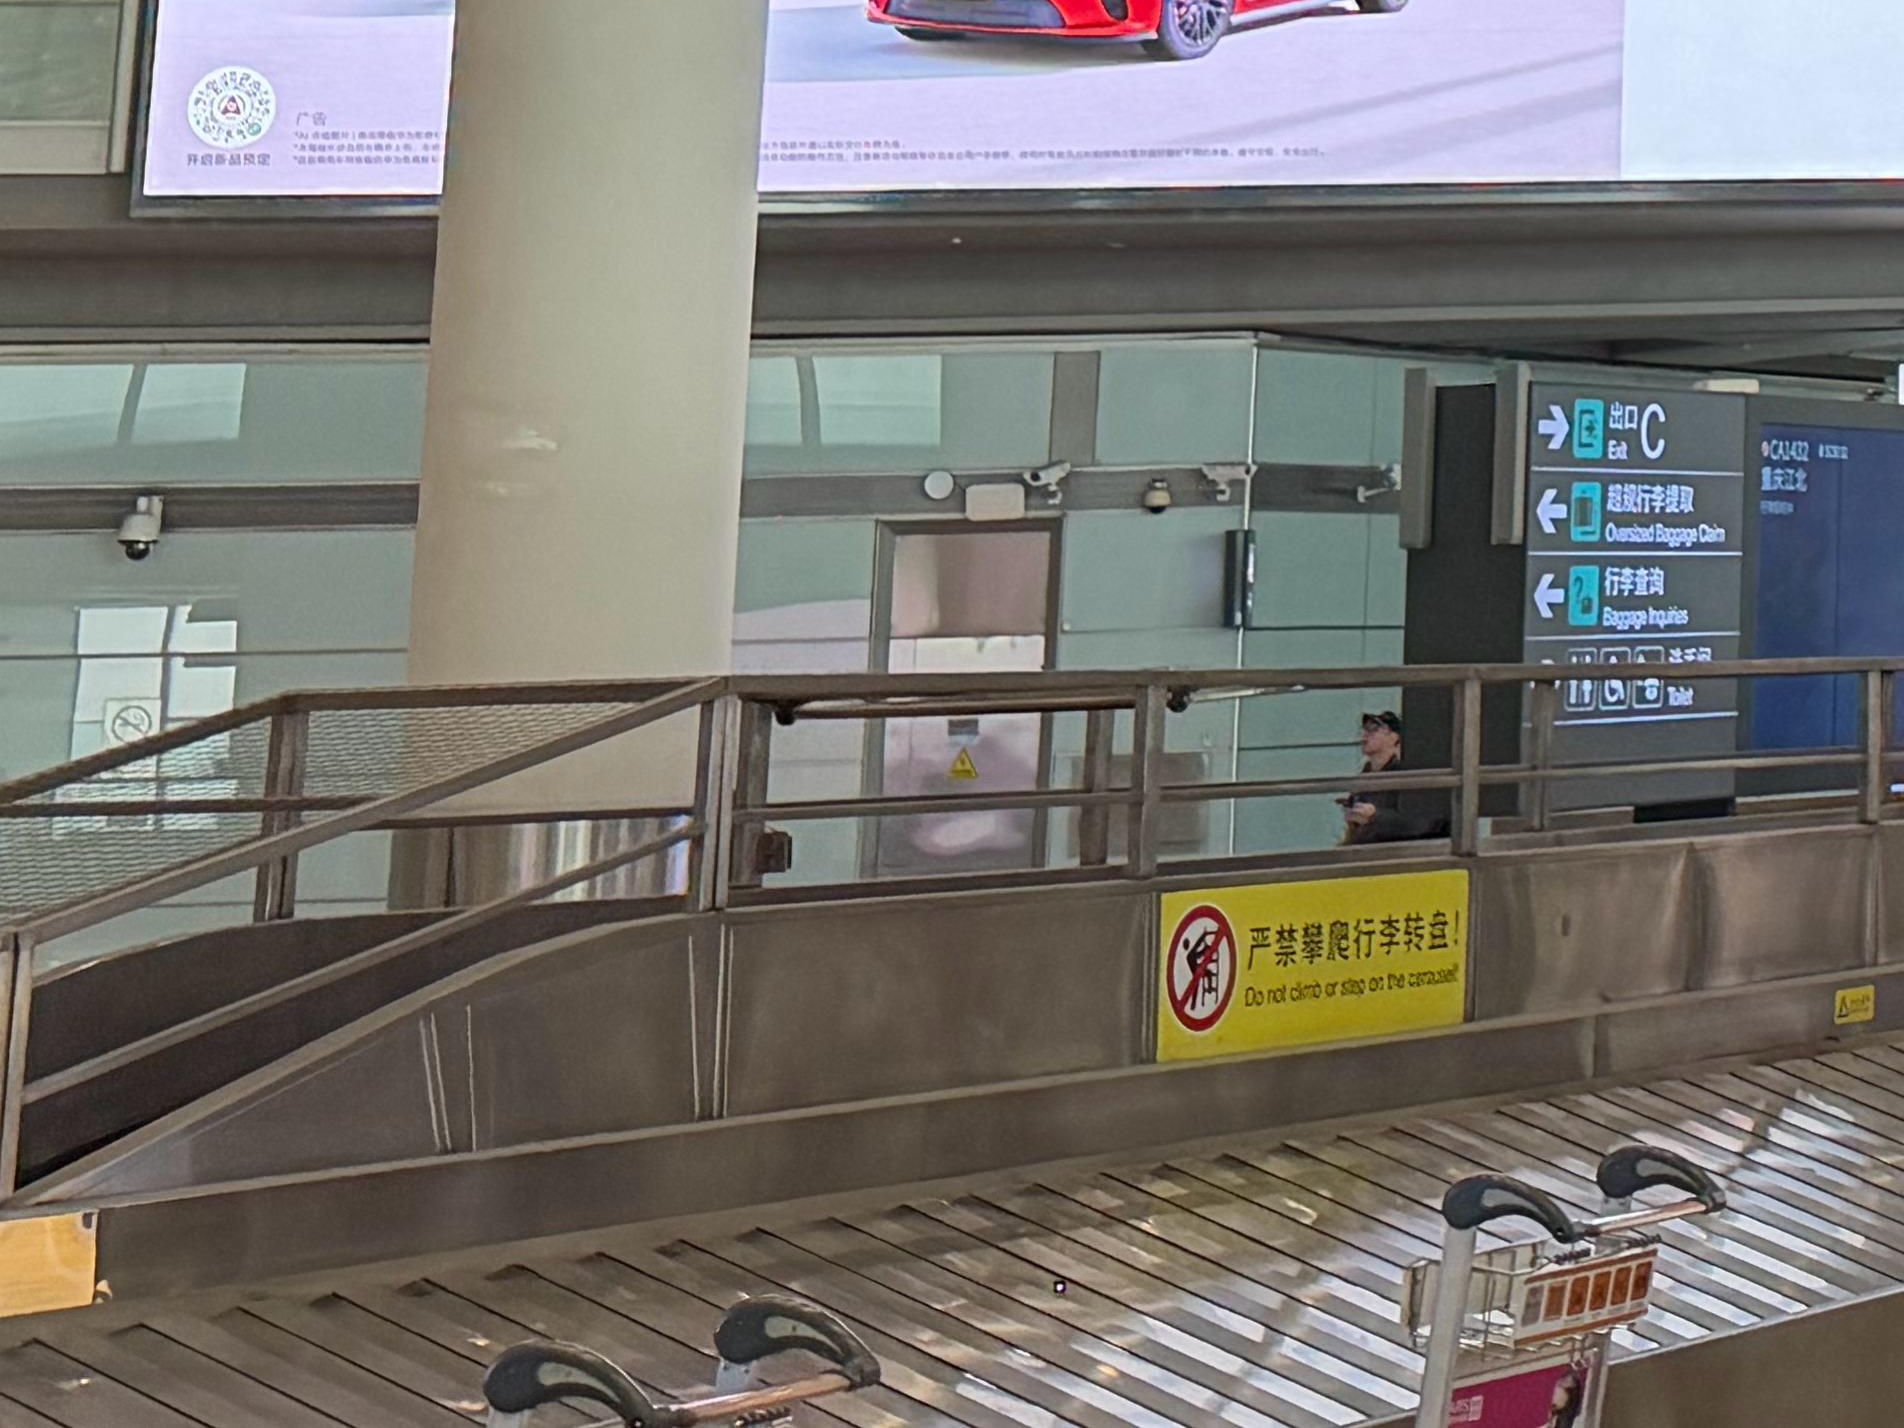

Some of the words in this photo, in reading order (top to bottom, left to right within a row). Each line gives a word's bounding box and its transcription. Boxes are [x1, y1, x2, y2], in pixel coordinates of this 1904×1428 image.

[1609, 401, 1639, 431] 出口
[1640, 402, 1667, 460] C
[1604, 565, 1665, 596] 行李查询
[1245, 985, 1265, 1007] Do
[1267, 984, 1287, 1005] not
[1324, 981, 1340, 998] or
